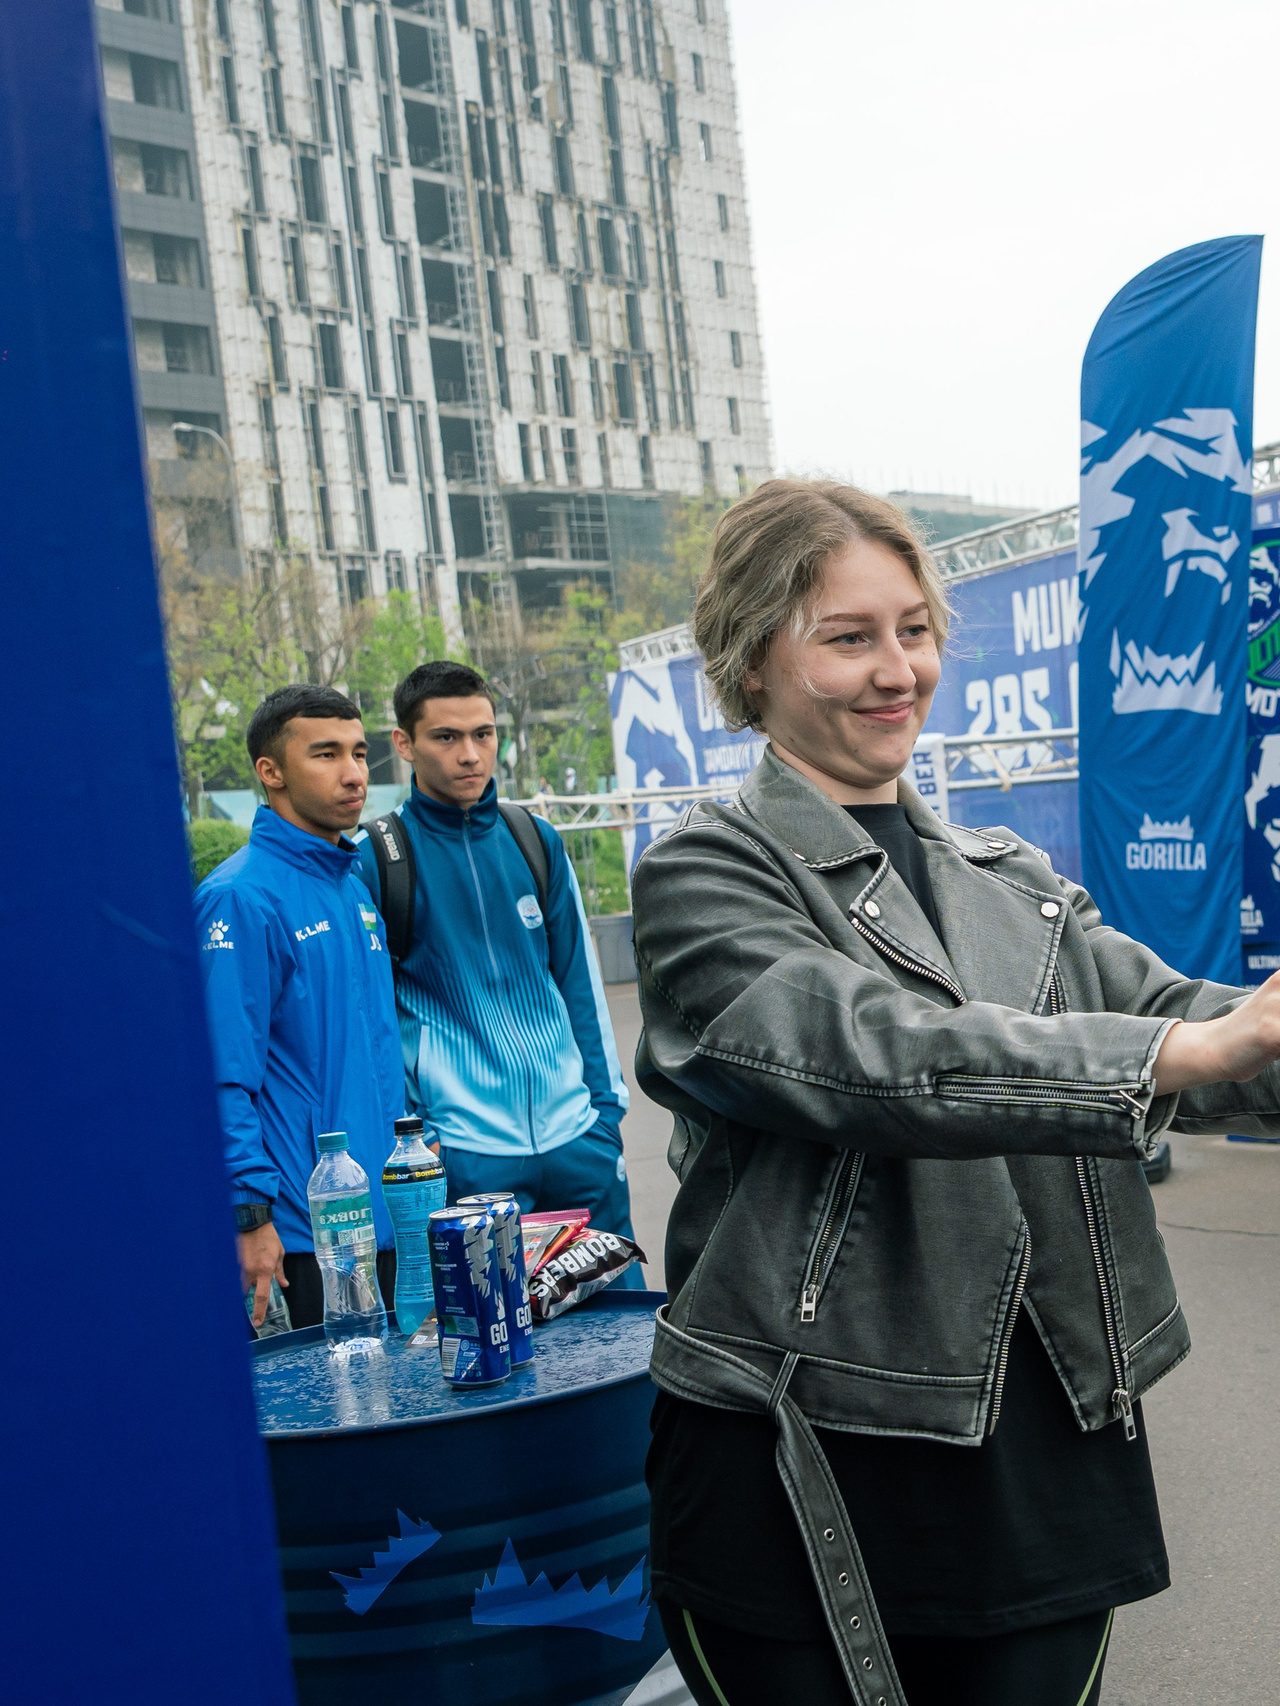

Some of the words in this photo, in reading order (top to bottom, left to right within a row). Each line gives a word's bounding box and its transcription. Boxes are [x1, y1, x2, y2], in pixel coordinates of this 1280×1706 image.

[383, 832, 401, 861] arena
[1126, 842, 1207, 872] GORILLA
[530, 1232, 621, 1298] BOMBERS
